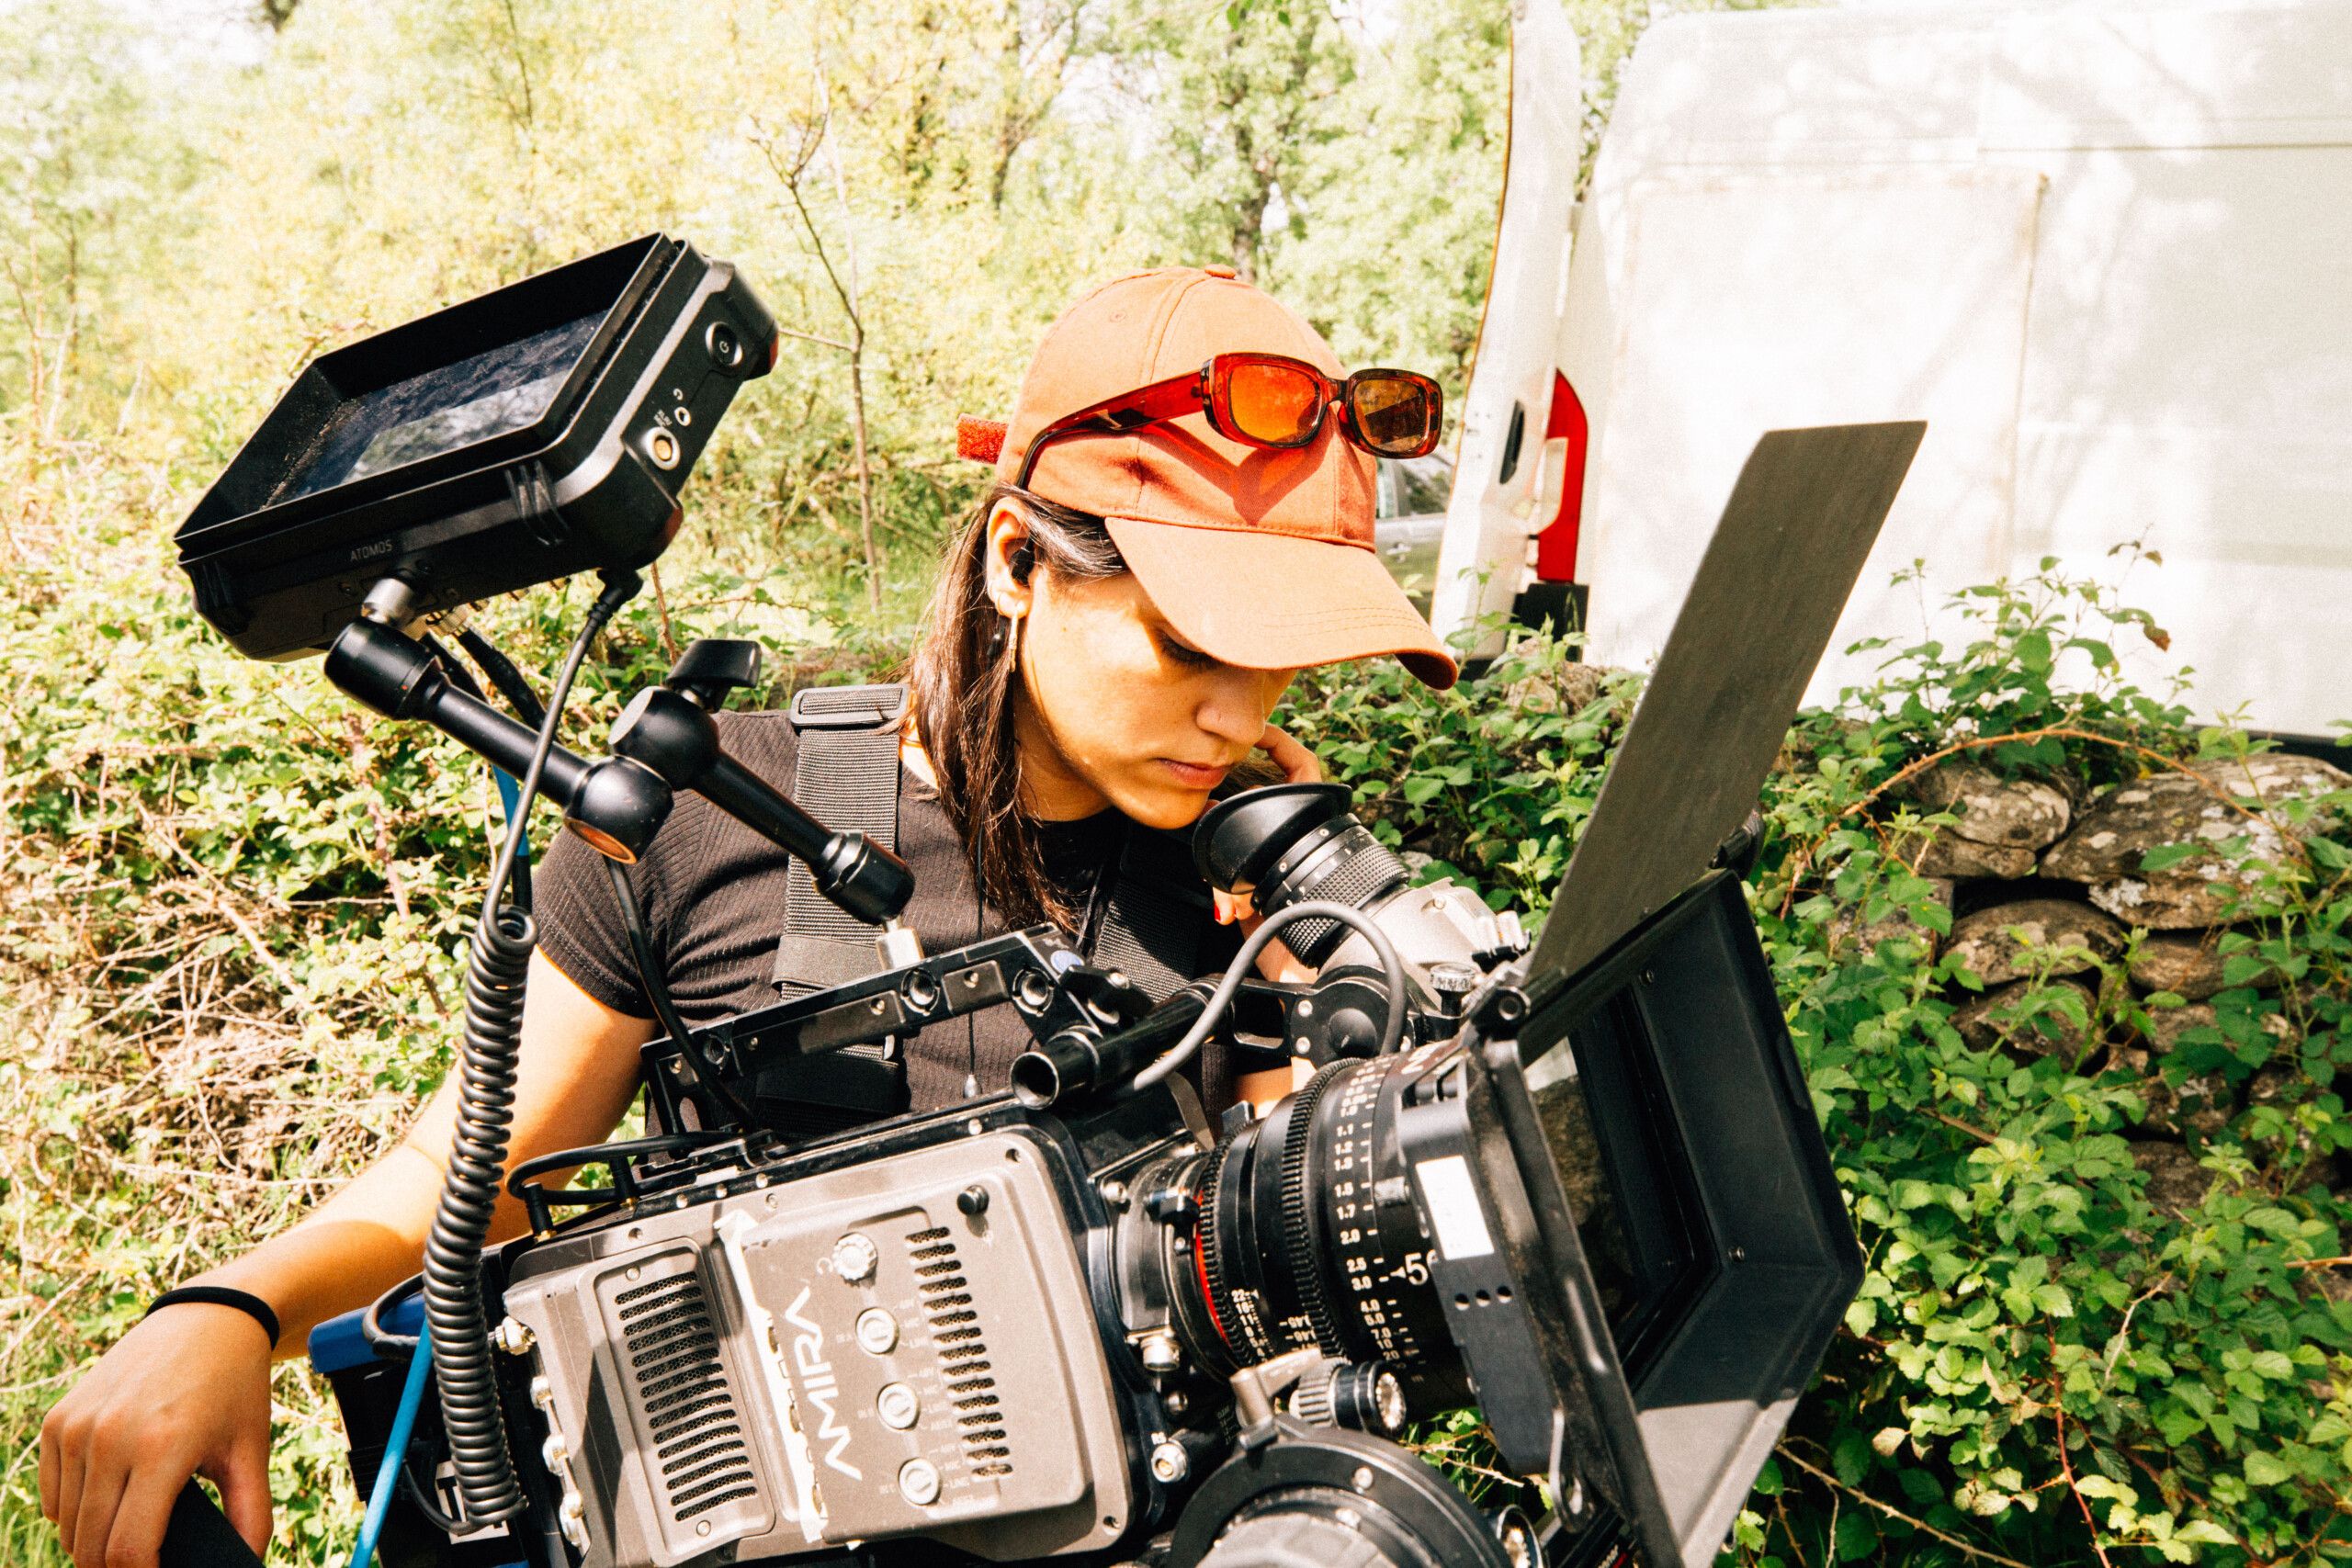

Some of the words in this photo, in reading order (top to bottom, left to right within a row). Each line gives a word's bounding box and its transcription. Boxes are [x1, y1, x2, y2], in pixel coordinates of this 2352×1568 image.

[351, 539, 393, 561] ATOMOS
[1337, 1122, 1354, 1136] 1.1
[1335, 1141, 1353, 1155] 1.2
[1334, 1156, 1353, 1171] 1.3
[1335, 1181, 1354, 1197] 1.5
[1337, 1203, 1355, 1220] 1.7
[1340, 1229, 1361, 1245] 2.0
[1346, 1257, 1367, 1273] 2.5
[1351, 1275, 1373, 1291] 3.0
[1231, 1289, 1247, 1303] 22
[1361, 1299, 1381, 1313] 4.0
[1240, 1313, 1255, 1326] 11
[1364, 1312, 1385, 1326] 5.0
[1371, 1326, 1392, 1339] 7.0
[1376, 1338, 1393, 1349] 10
[785, 1286, 863, 1481] AMIRA
